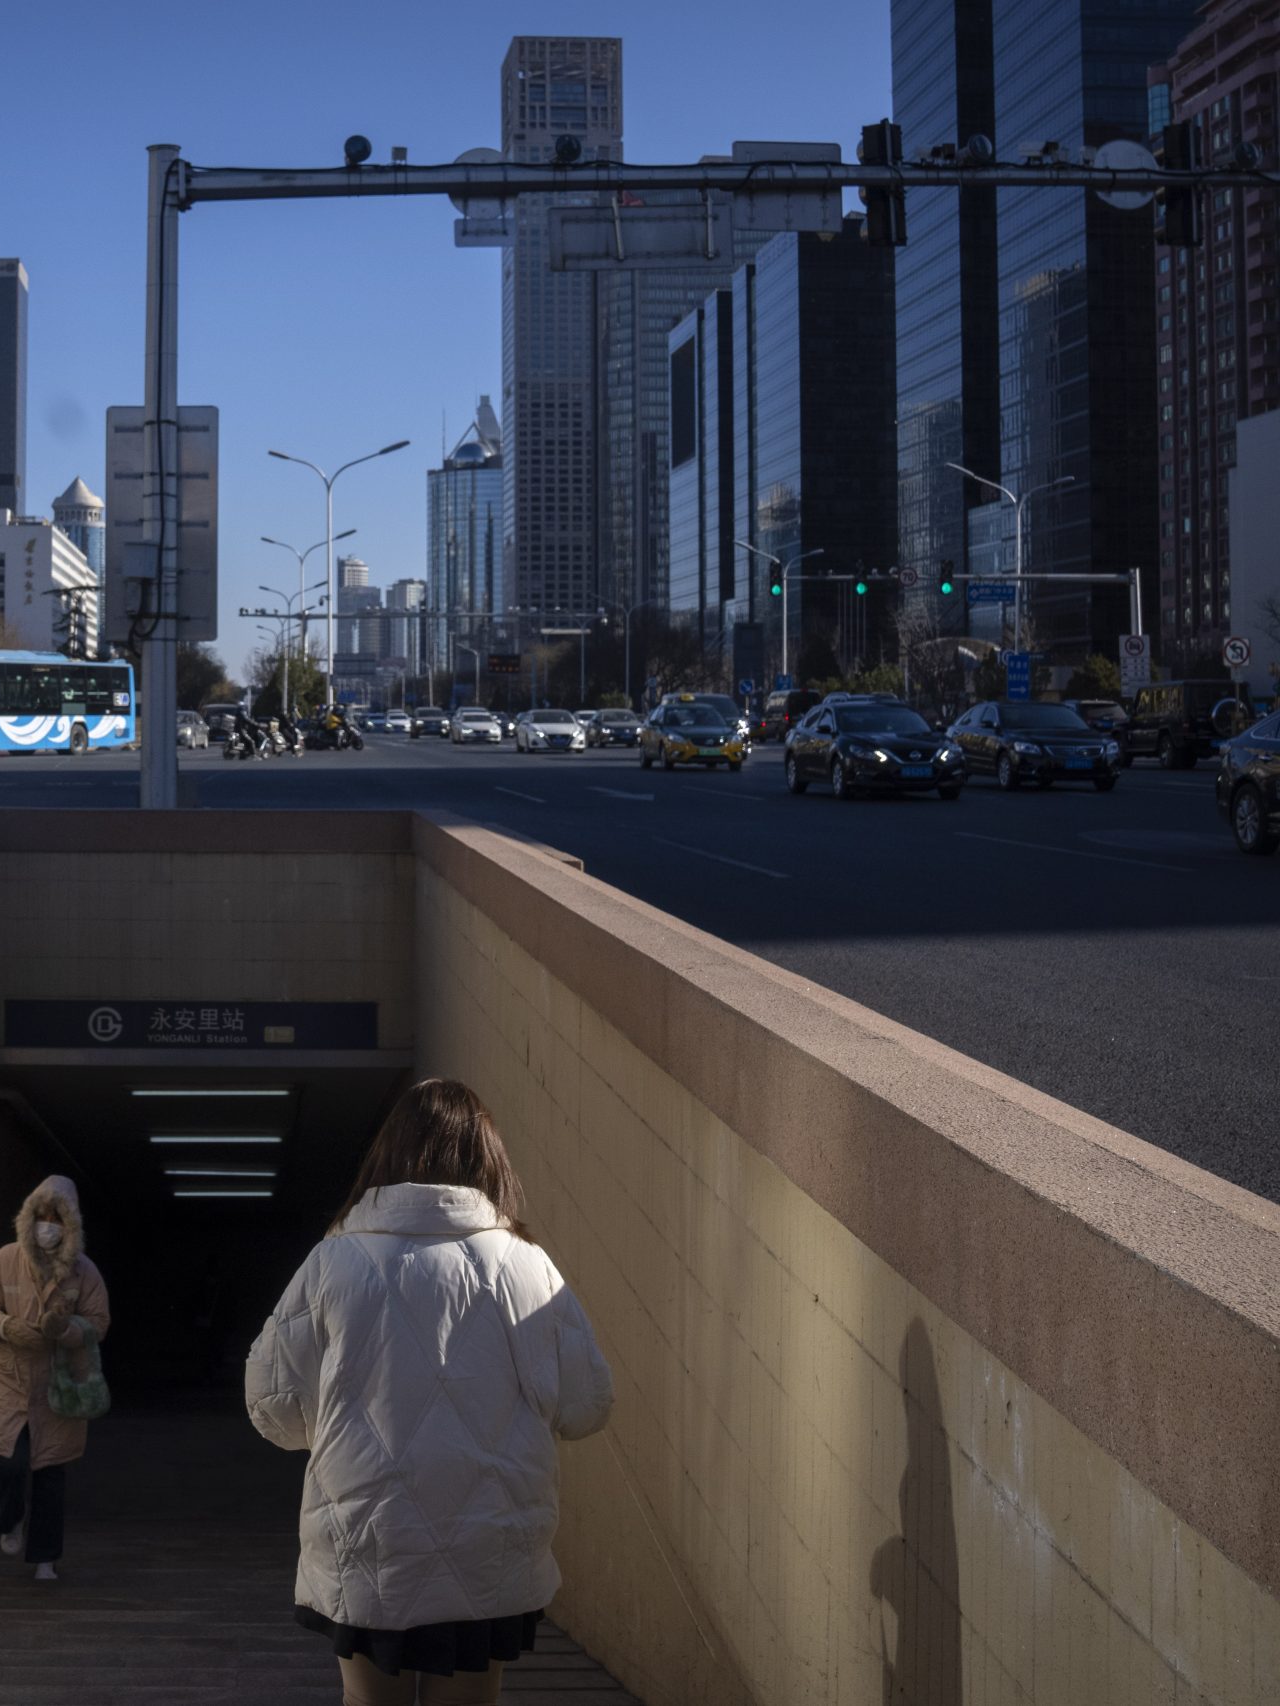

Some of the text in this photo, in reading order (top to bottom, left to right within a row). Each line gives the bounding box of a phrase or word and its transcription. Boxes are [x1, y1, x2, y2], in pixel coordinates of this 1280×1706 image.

[149, 1007, 245, 1031] 永安里站
[146, 1033, 248, 1044] YONGANLI Station
